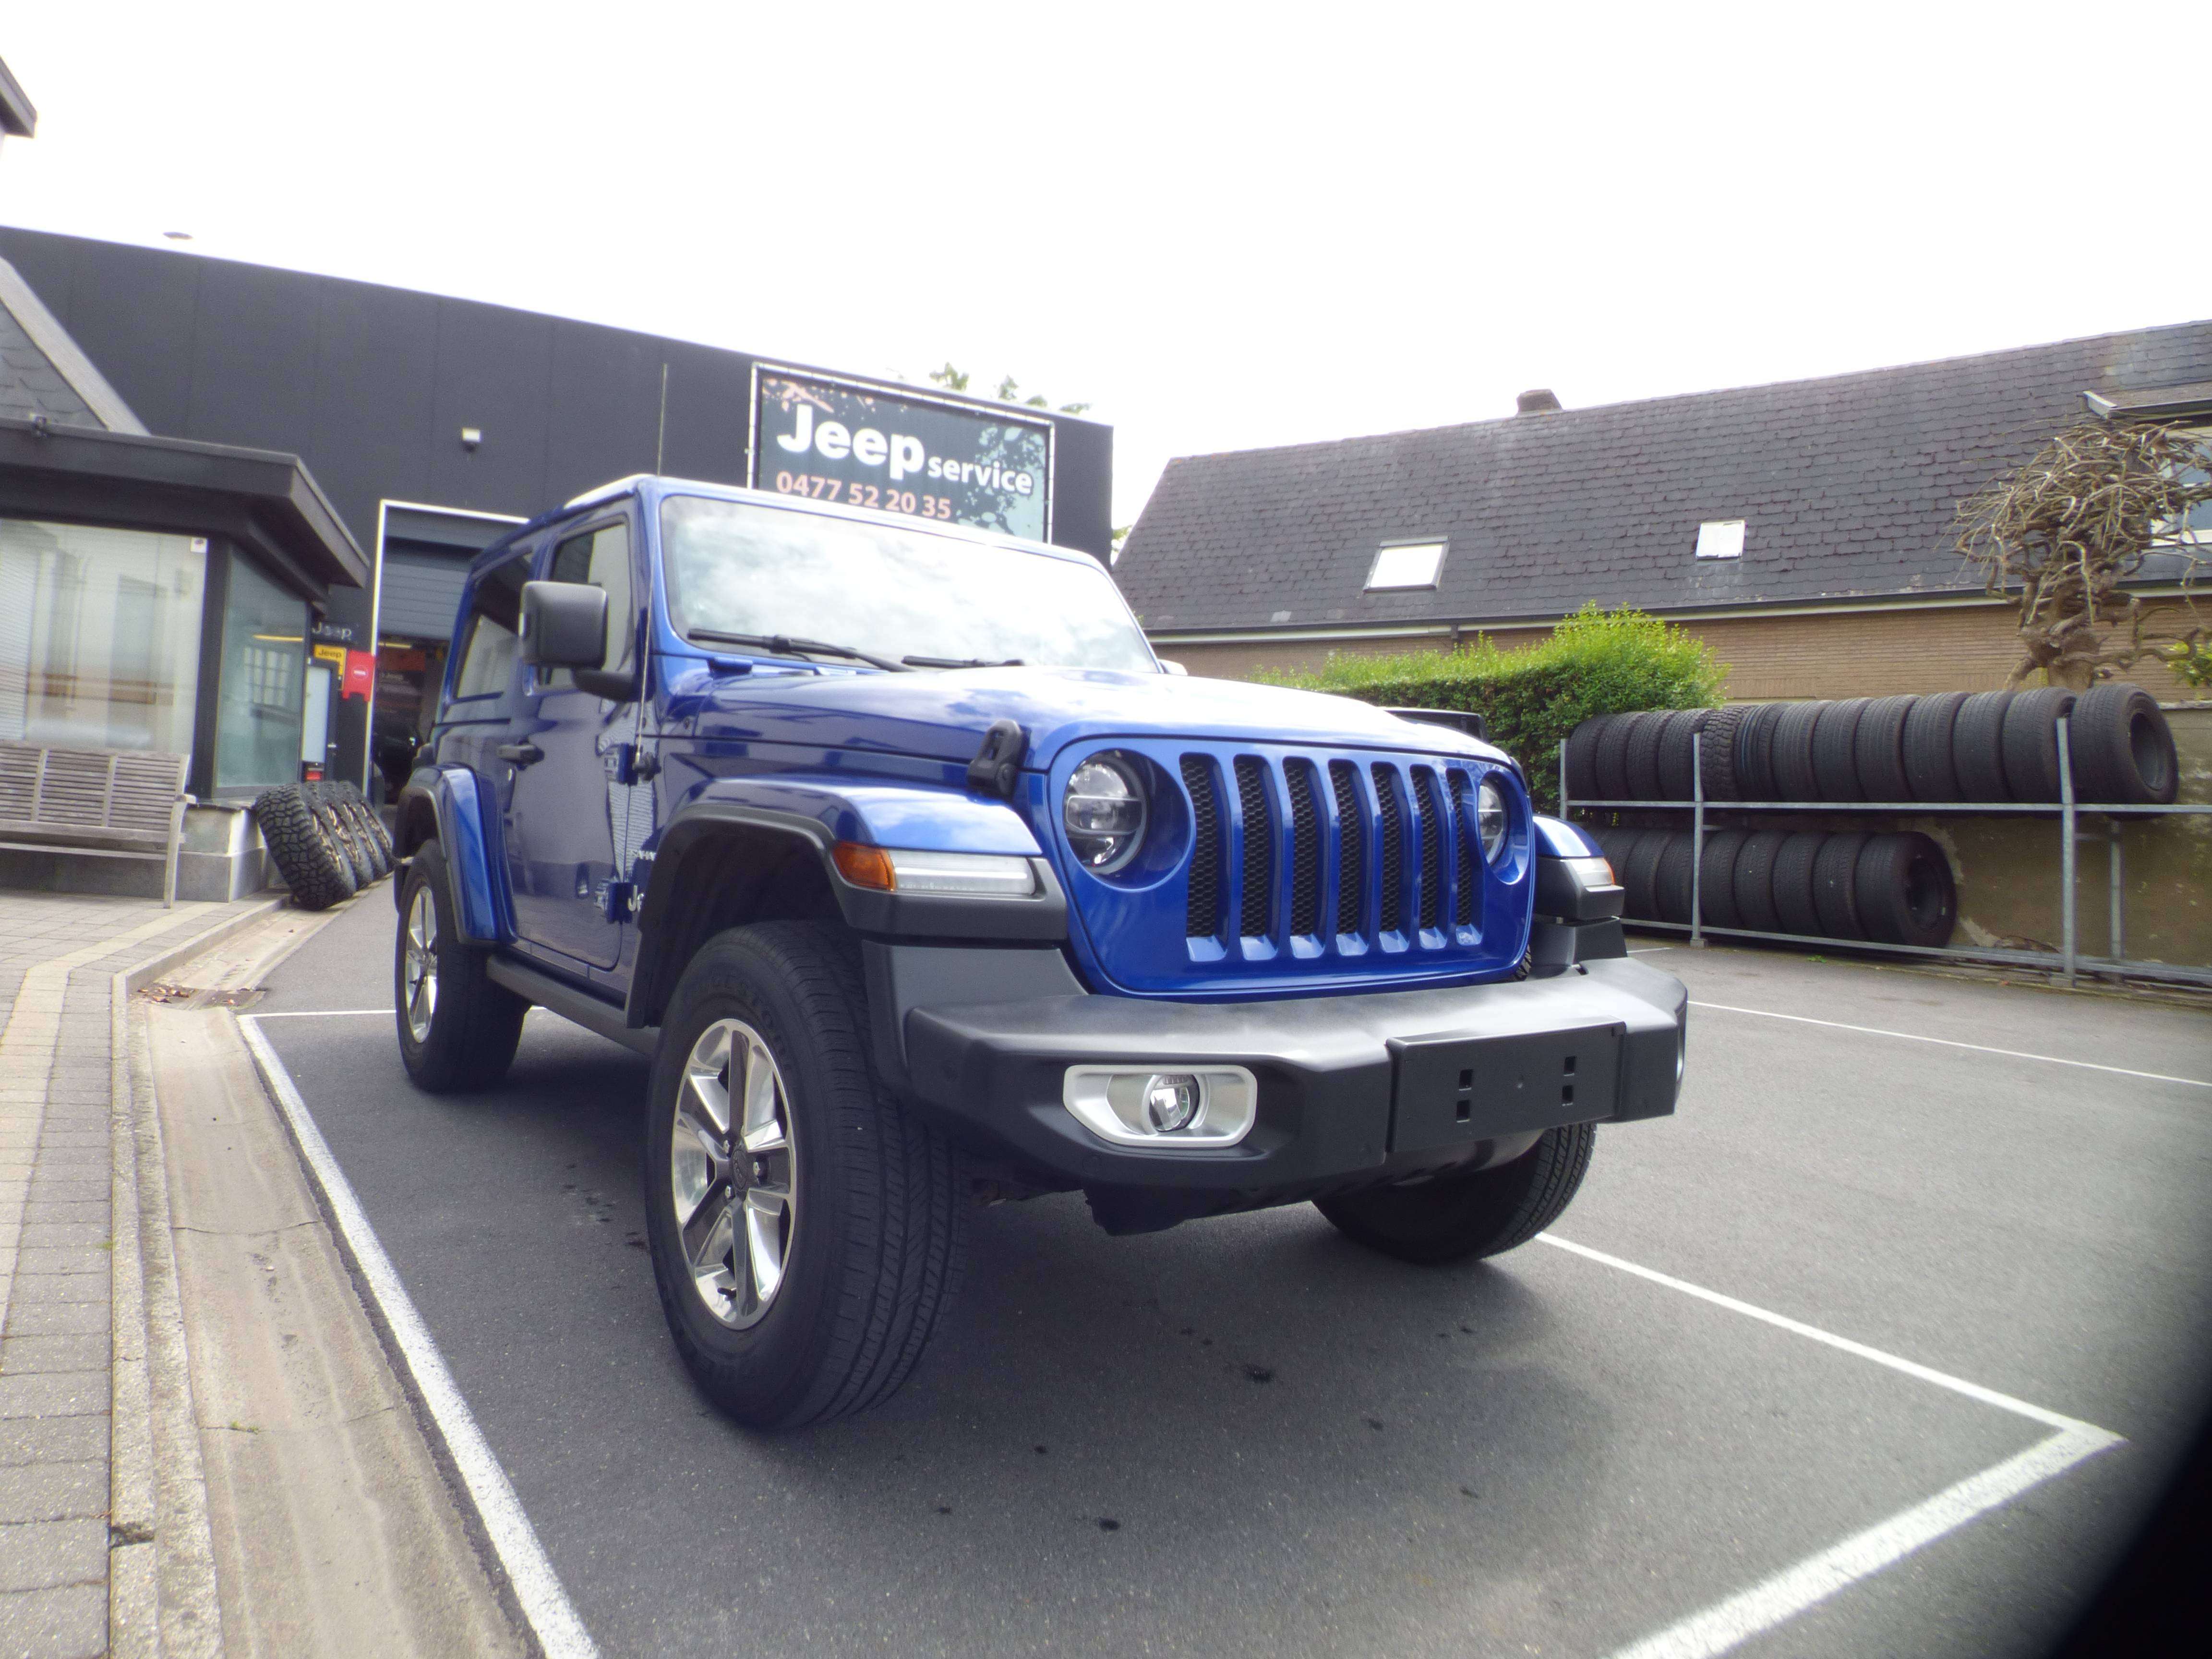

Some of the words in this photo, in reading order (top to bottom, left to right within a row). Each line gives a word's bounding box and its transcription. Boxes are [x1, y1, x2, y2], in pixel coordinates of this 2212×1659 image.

[777, 404, 925, 481] Jeep
[927, 456, 1033, 494] service
[776, 470, 842, 501] 0477
[848, 482, 879, 508] 52
[885, 488, 916, 514] 20
[922, 494, 951, 519] 35
